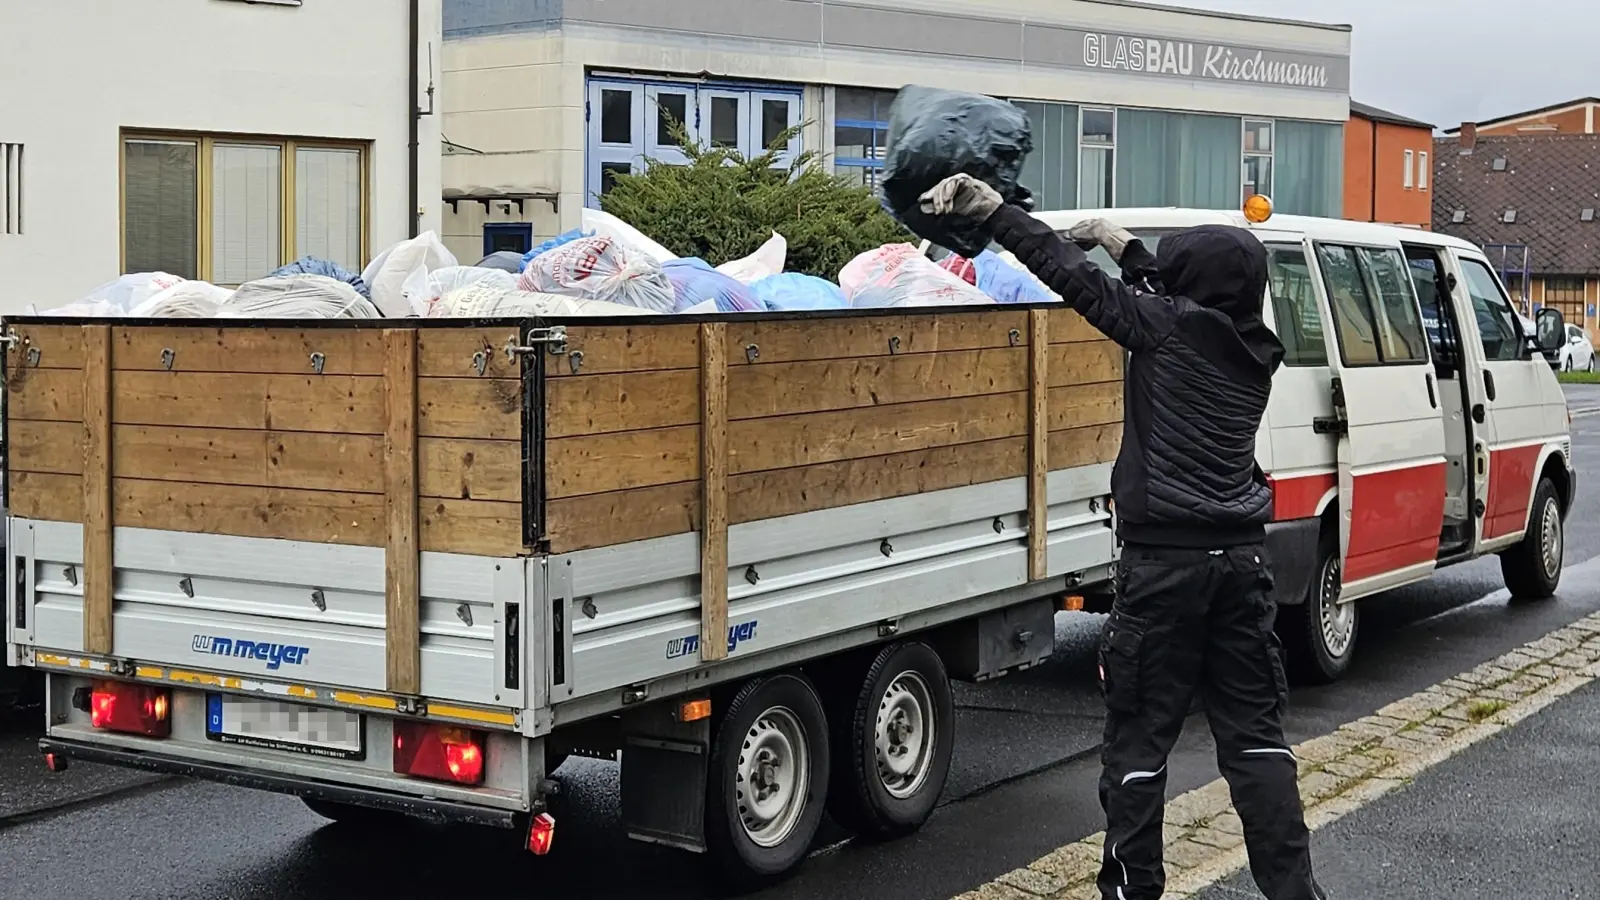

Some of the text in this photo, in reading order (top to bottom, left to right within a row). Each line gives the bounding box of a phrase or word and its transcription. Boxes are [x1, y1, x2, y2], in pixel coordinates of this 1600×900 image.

[1083, 33, 1328, 87] GLASBAU Kirchmann
[233, 639, 309, 670] meyer
[212, 715, 219, 725] D
